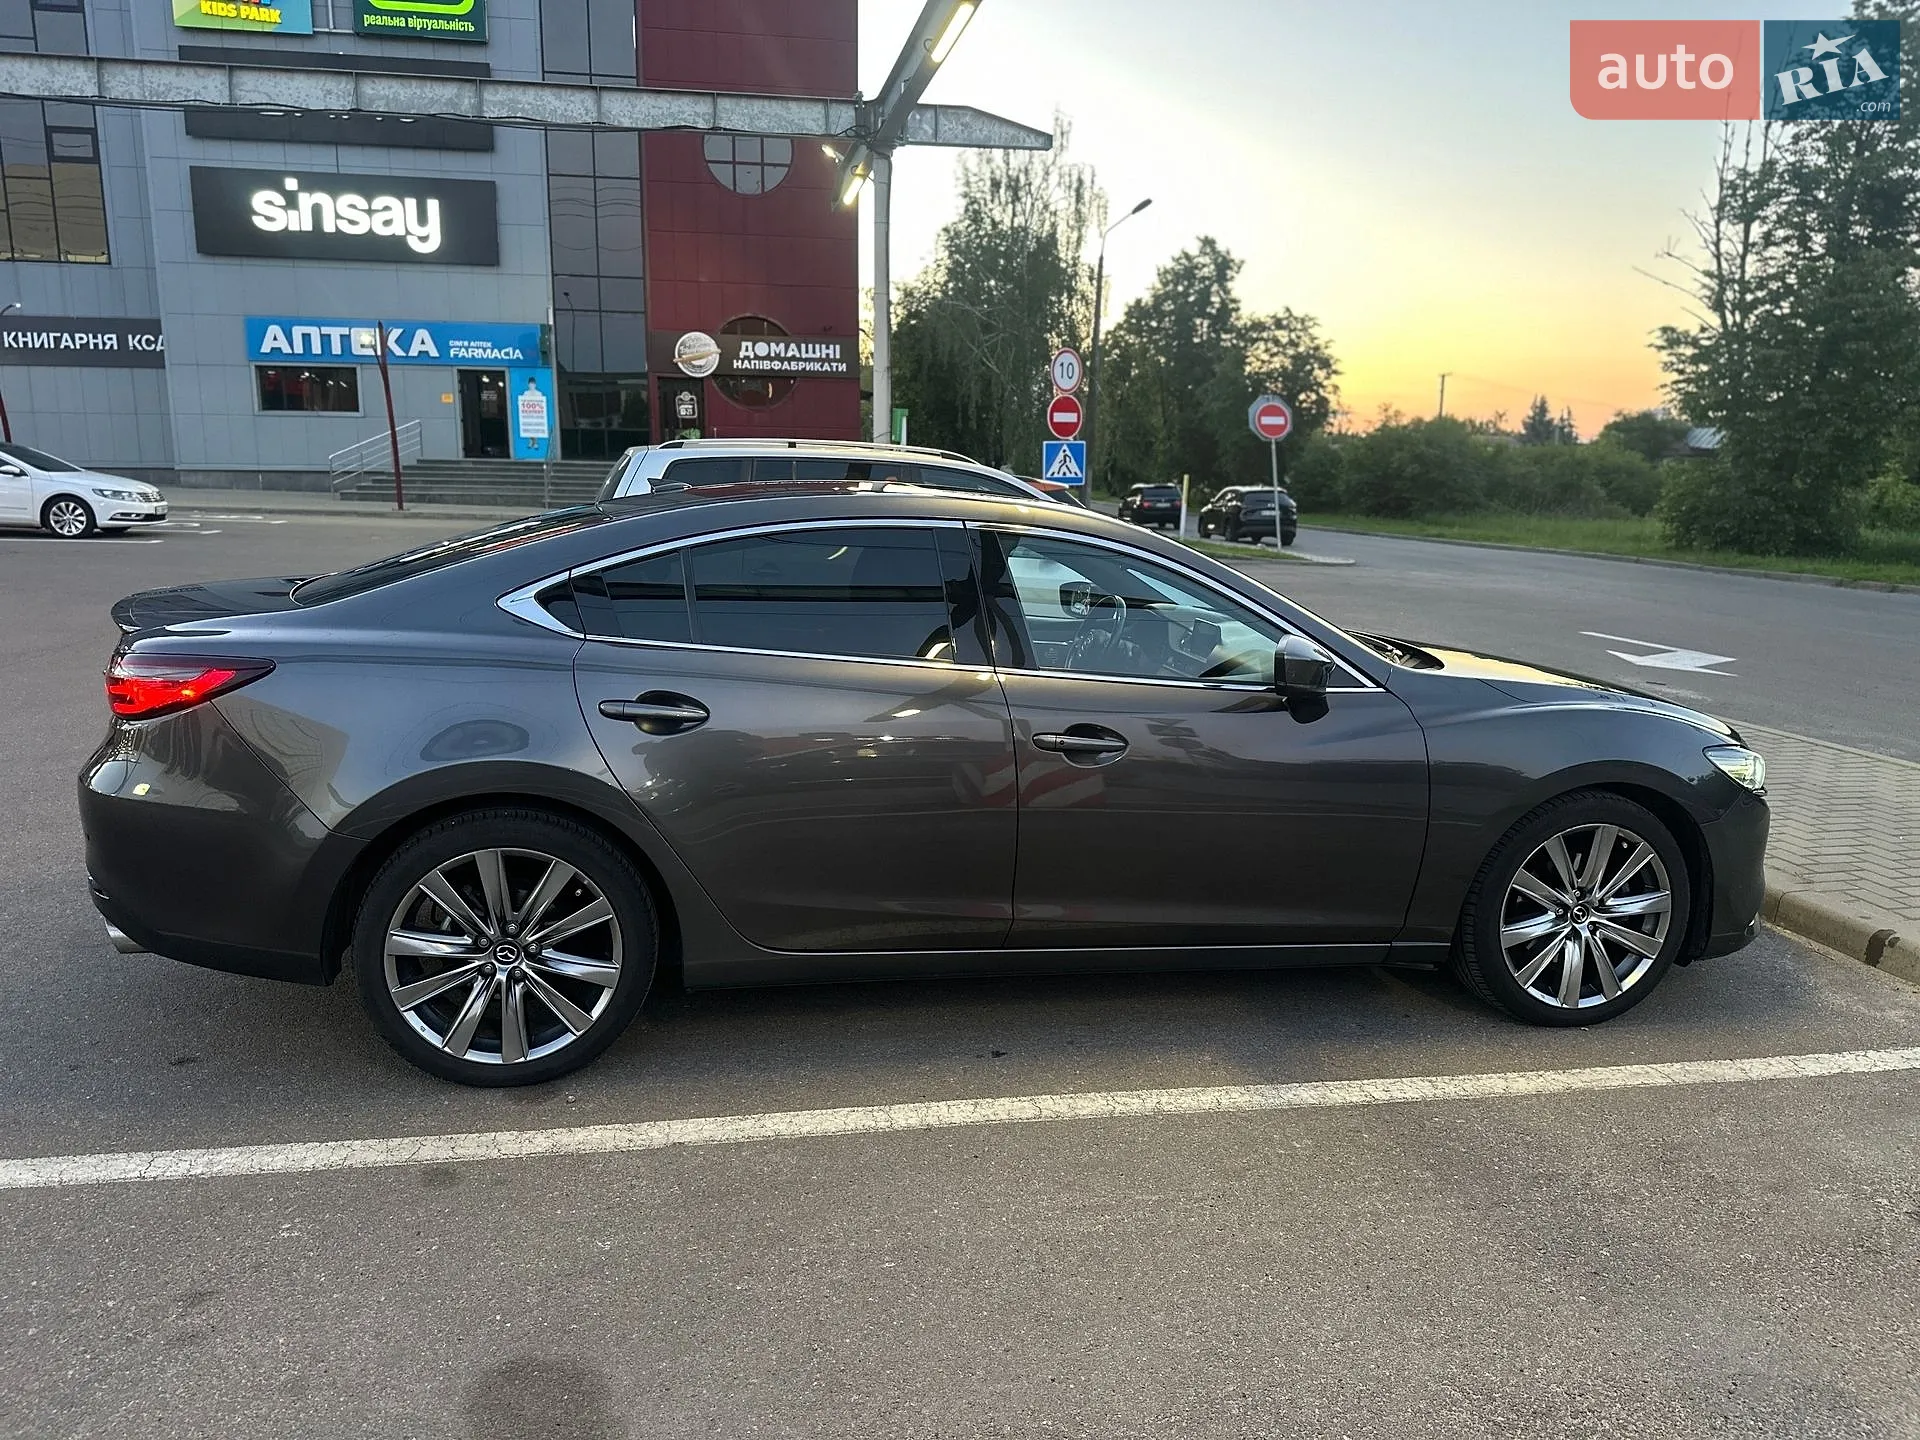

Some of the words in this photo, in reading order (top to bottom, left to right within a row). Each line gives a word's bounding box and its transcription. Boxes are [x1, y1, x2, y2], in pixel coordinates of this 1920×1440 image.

[200, 1, 238, 18] KIDS
[240, 5, 282, 24] PARK
[363, 14, 406, 27] реальна
[407, 15, 475, 32] віртуальність
[252, 177, 442, 254] sinsay
[3, 331, 118, 350] КНИГАРНЯ
[260, 324, 440, 358] АПТЕКА
[739, 341, 841, 359] ДОМАШНІ
[733, 359, 847, 372] НАПІВФАБРИКАТИ
[1059, 361, 1075, 380] 10
